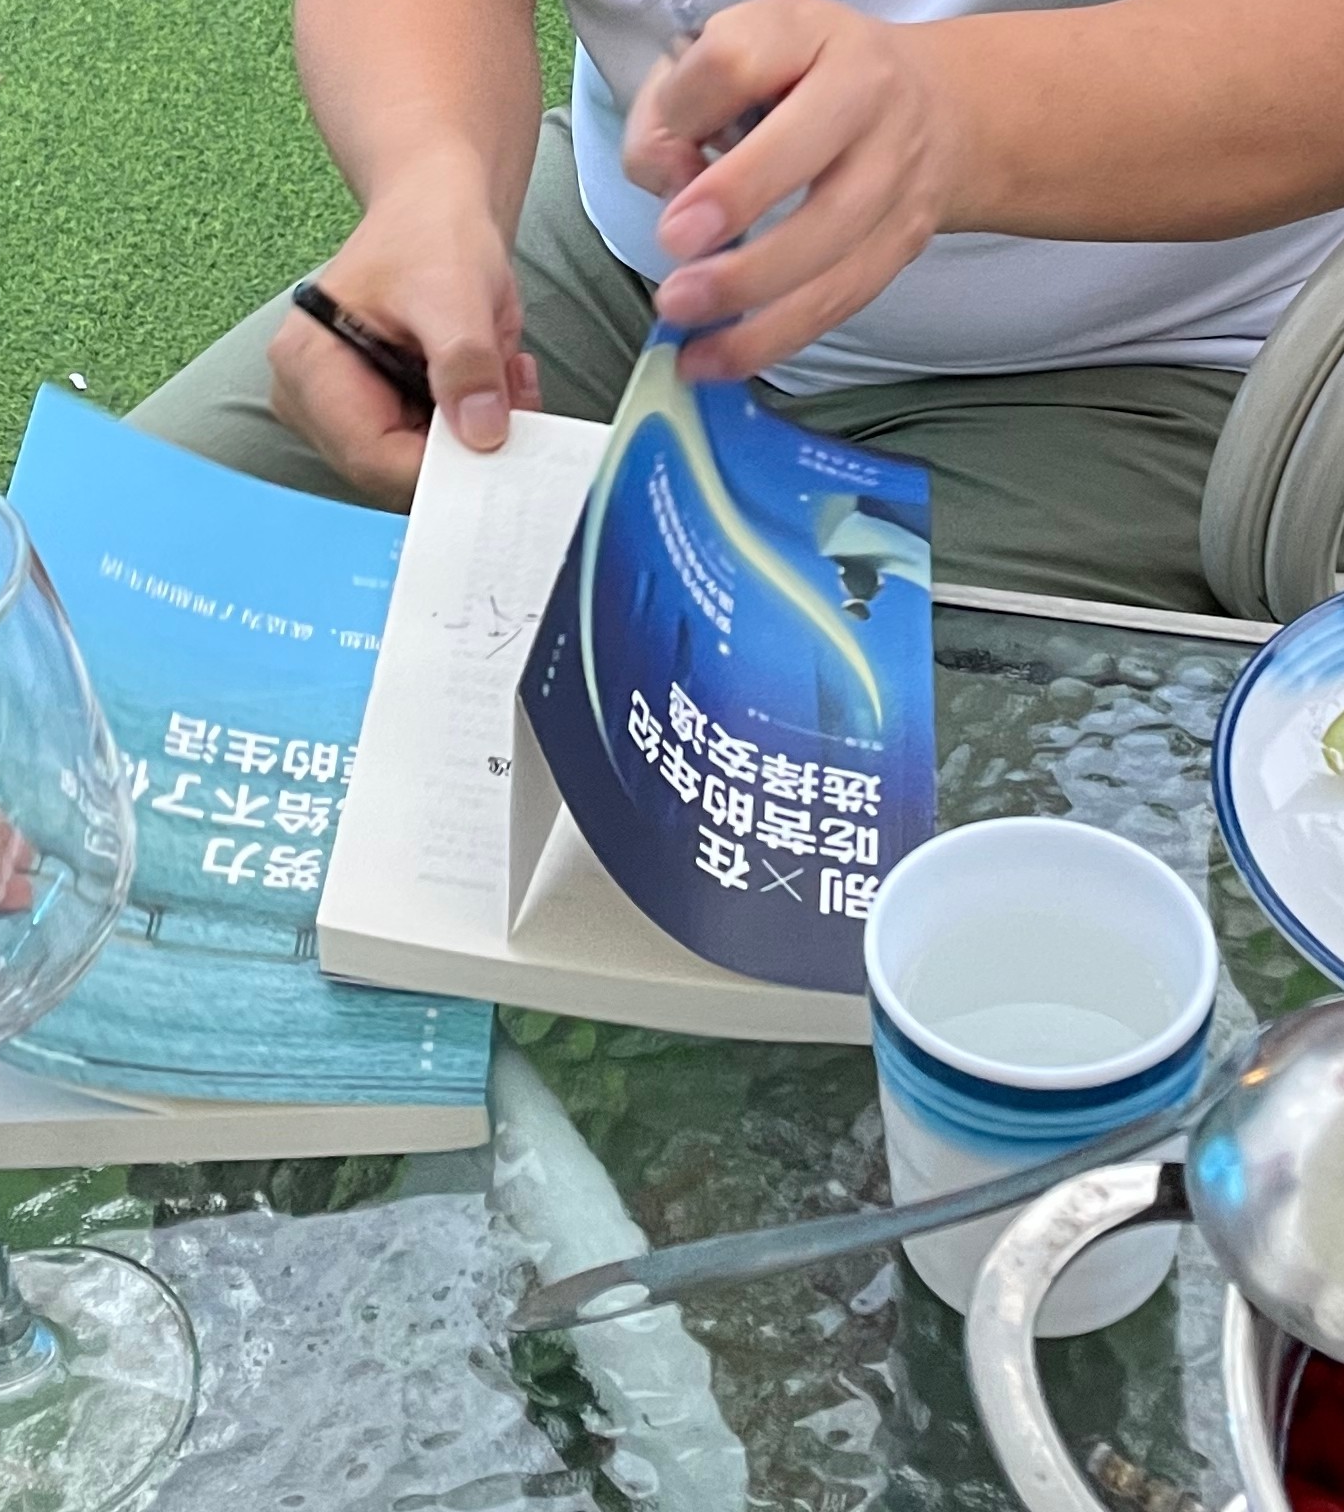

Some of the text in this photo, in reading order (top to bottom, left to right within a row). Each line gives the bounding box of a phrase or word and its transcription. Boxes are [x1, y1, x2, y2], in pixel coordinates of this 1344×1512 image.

[626, 689, 880, 866] 吃苦的年纪
[668, 681, 882, 817] 选择安逸
[202, 838, 323, 891] 努力
